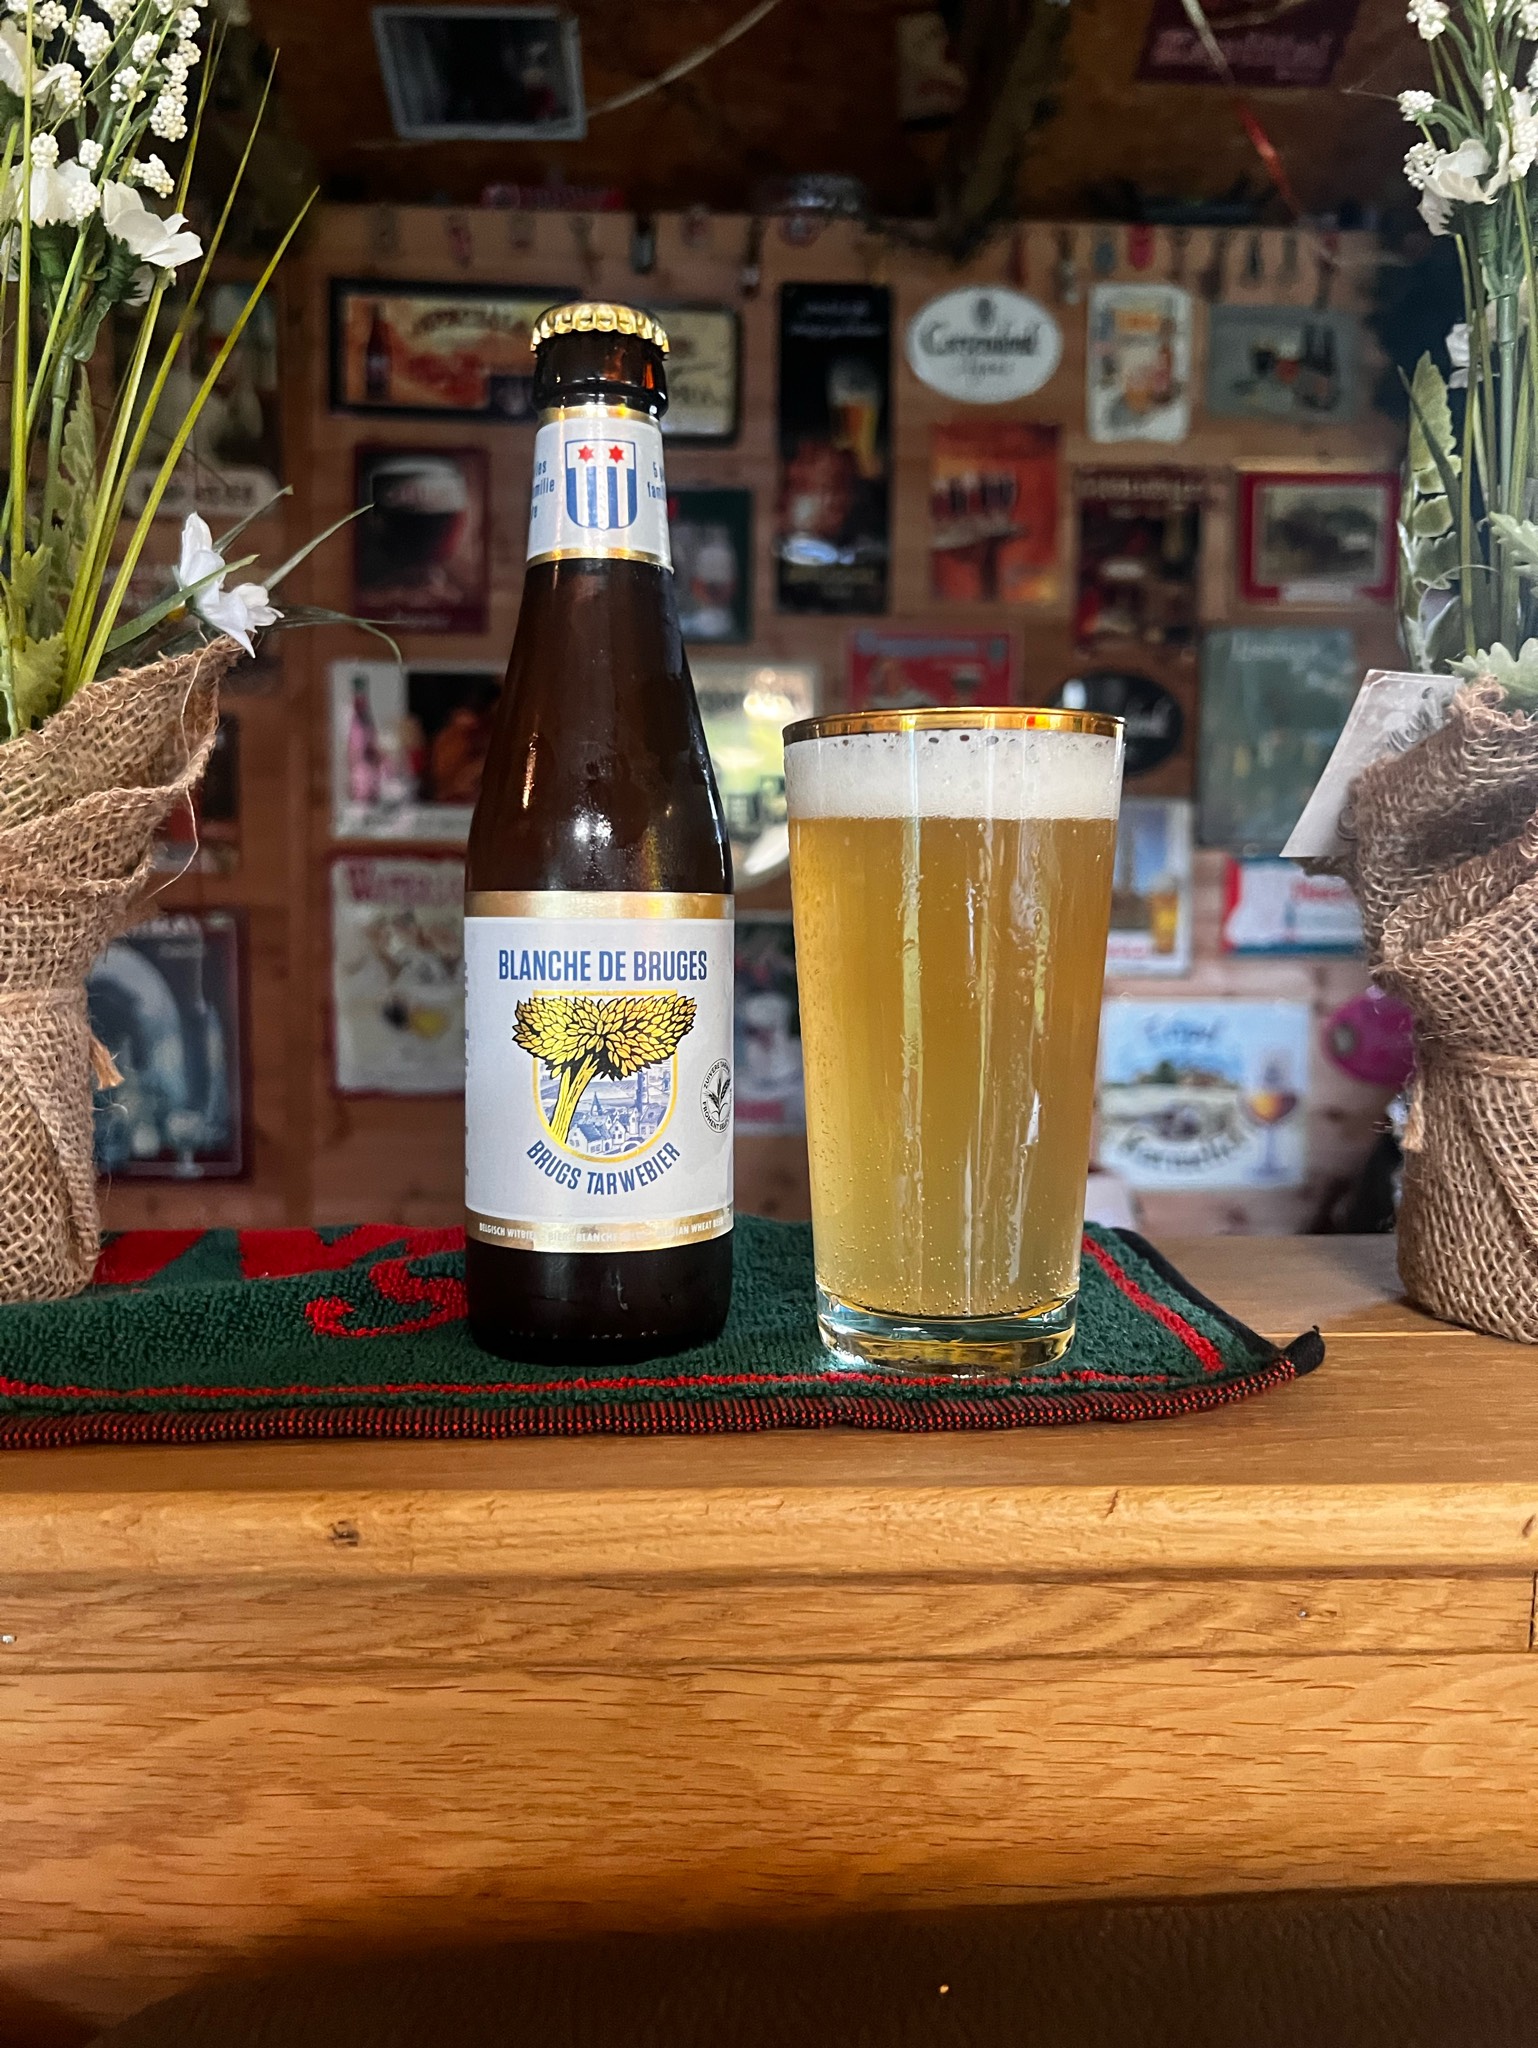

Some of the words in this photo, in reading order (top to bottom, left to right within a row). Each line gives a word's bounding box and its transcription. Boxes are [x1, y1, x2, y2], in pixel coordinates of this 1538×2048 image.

[499, 949, 591, 982] BLANCHE
[599, 950, 627, 982] DE
[633, 950, 707, 982] BRUGES
[526, 1139, 582, 1190] BRUGS
[587, 1141, 681, 1195] TARWEBIER
[479, 1222, 506, 1237] BELGISCH
[691, 1220, 713, 1233] WHEAT
